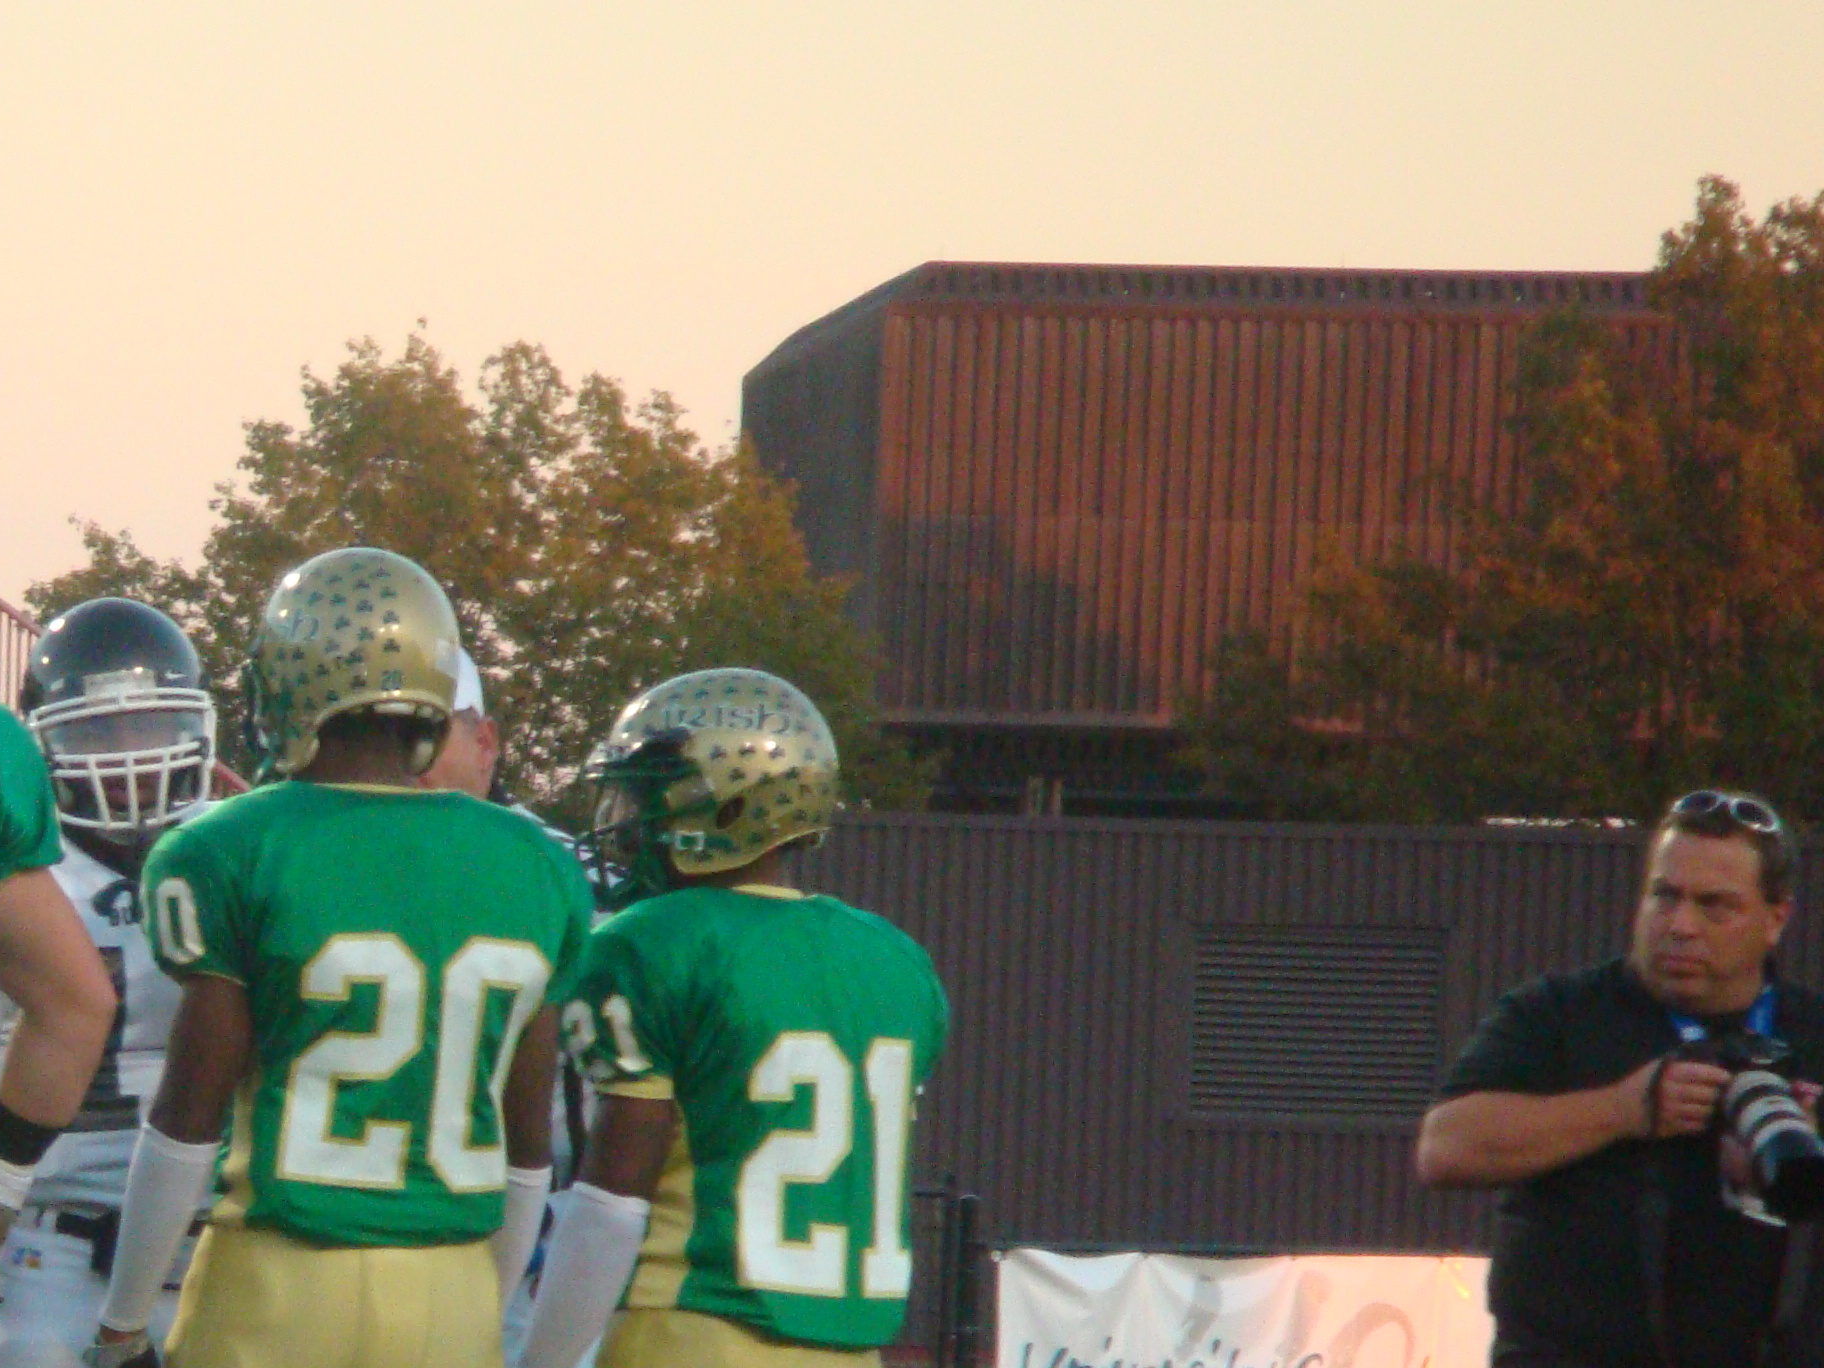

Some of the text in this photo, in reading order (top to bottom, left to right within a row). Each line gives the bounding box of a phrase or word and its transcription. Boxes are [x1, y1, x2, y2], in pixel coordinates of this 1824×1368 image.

[276, 931, 552, 1194] 20
[561, 993, 654, 1080] 21
[737, 1030, 914, 1300] 21
